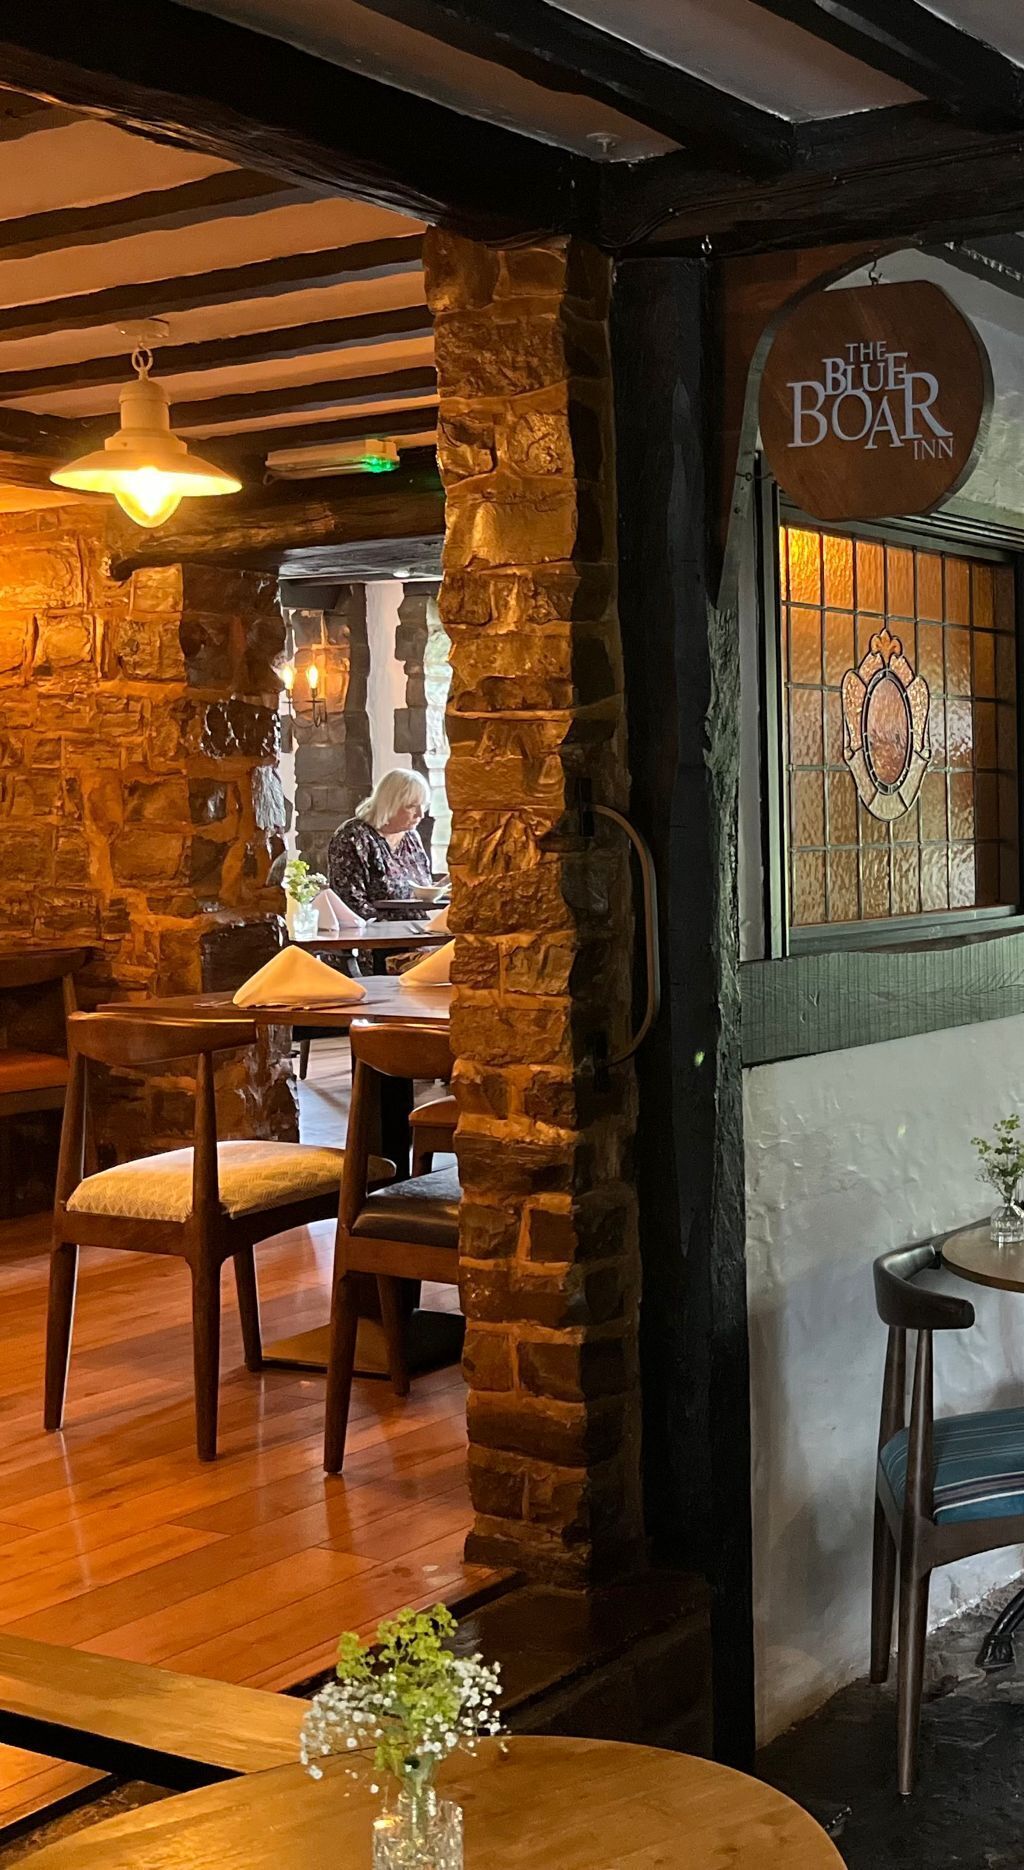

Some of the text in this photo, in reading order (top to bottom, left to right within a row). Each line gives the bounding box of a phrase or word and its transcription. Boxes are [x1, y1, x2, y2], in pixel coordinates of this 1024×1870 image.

[845, 341, 887, 362] THE
[821, 352, 908, 395] BLUE
[786, 372, 953, 449] BOAR
[913, 438, 954, 460] INN
